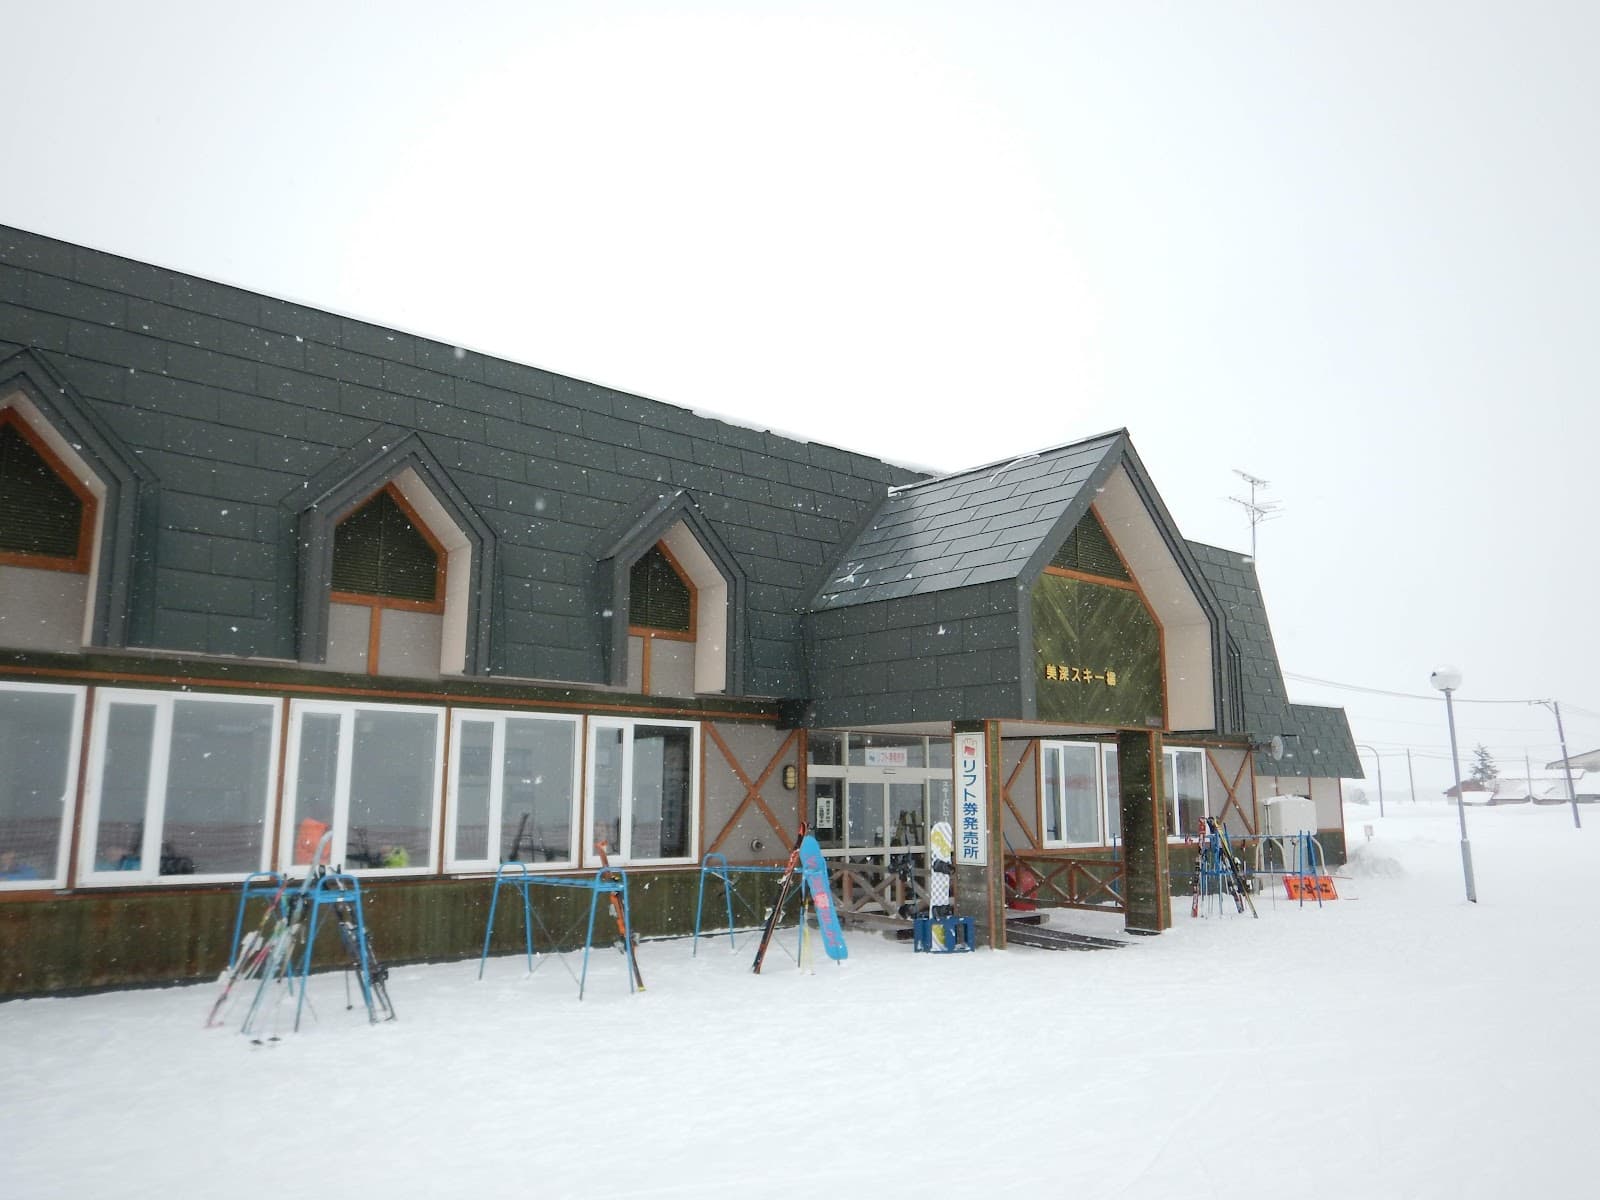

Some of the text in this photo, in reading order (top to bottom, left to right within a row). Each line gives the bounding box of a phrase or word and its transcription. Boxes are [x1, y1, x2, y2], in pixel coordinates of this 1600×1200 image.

[963, 759, 978, 859] リフト券発売所
